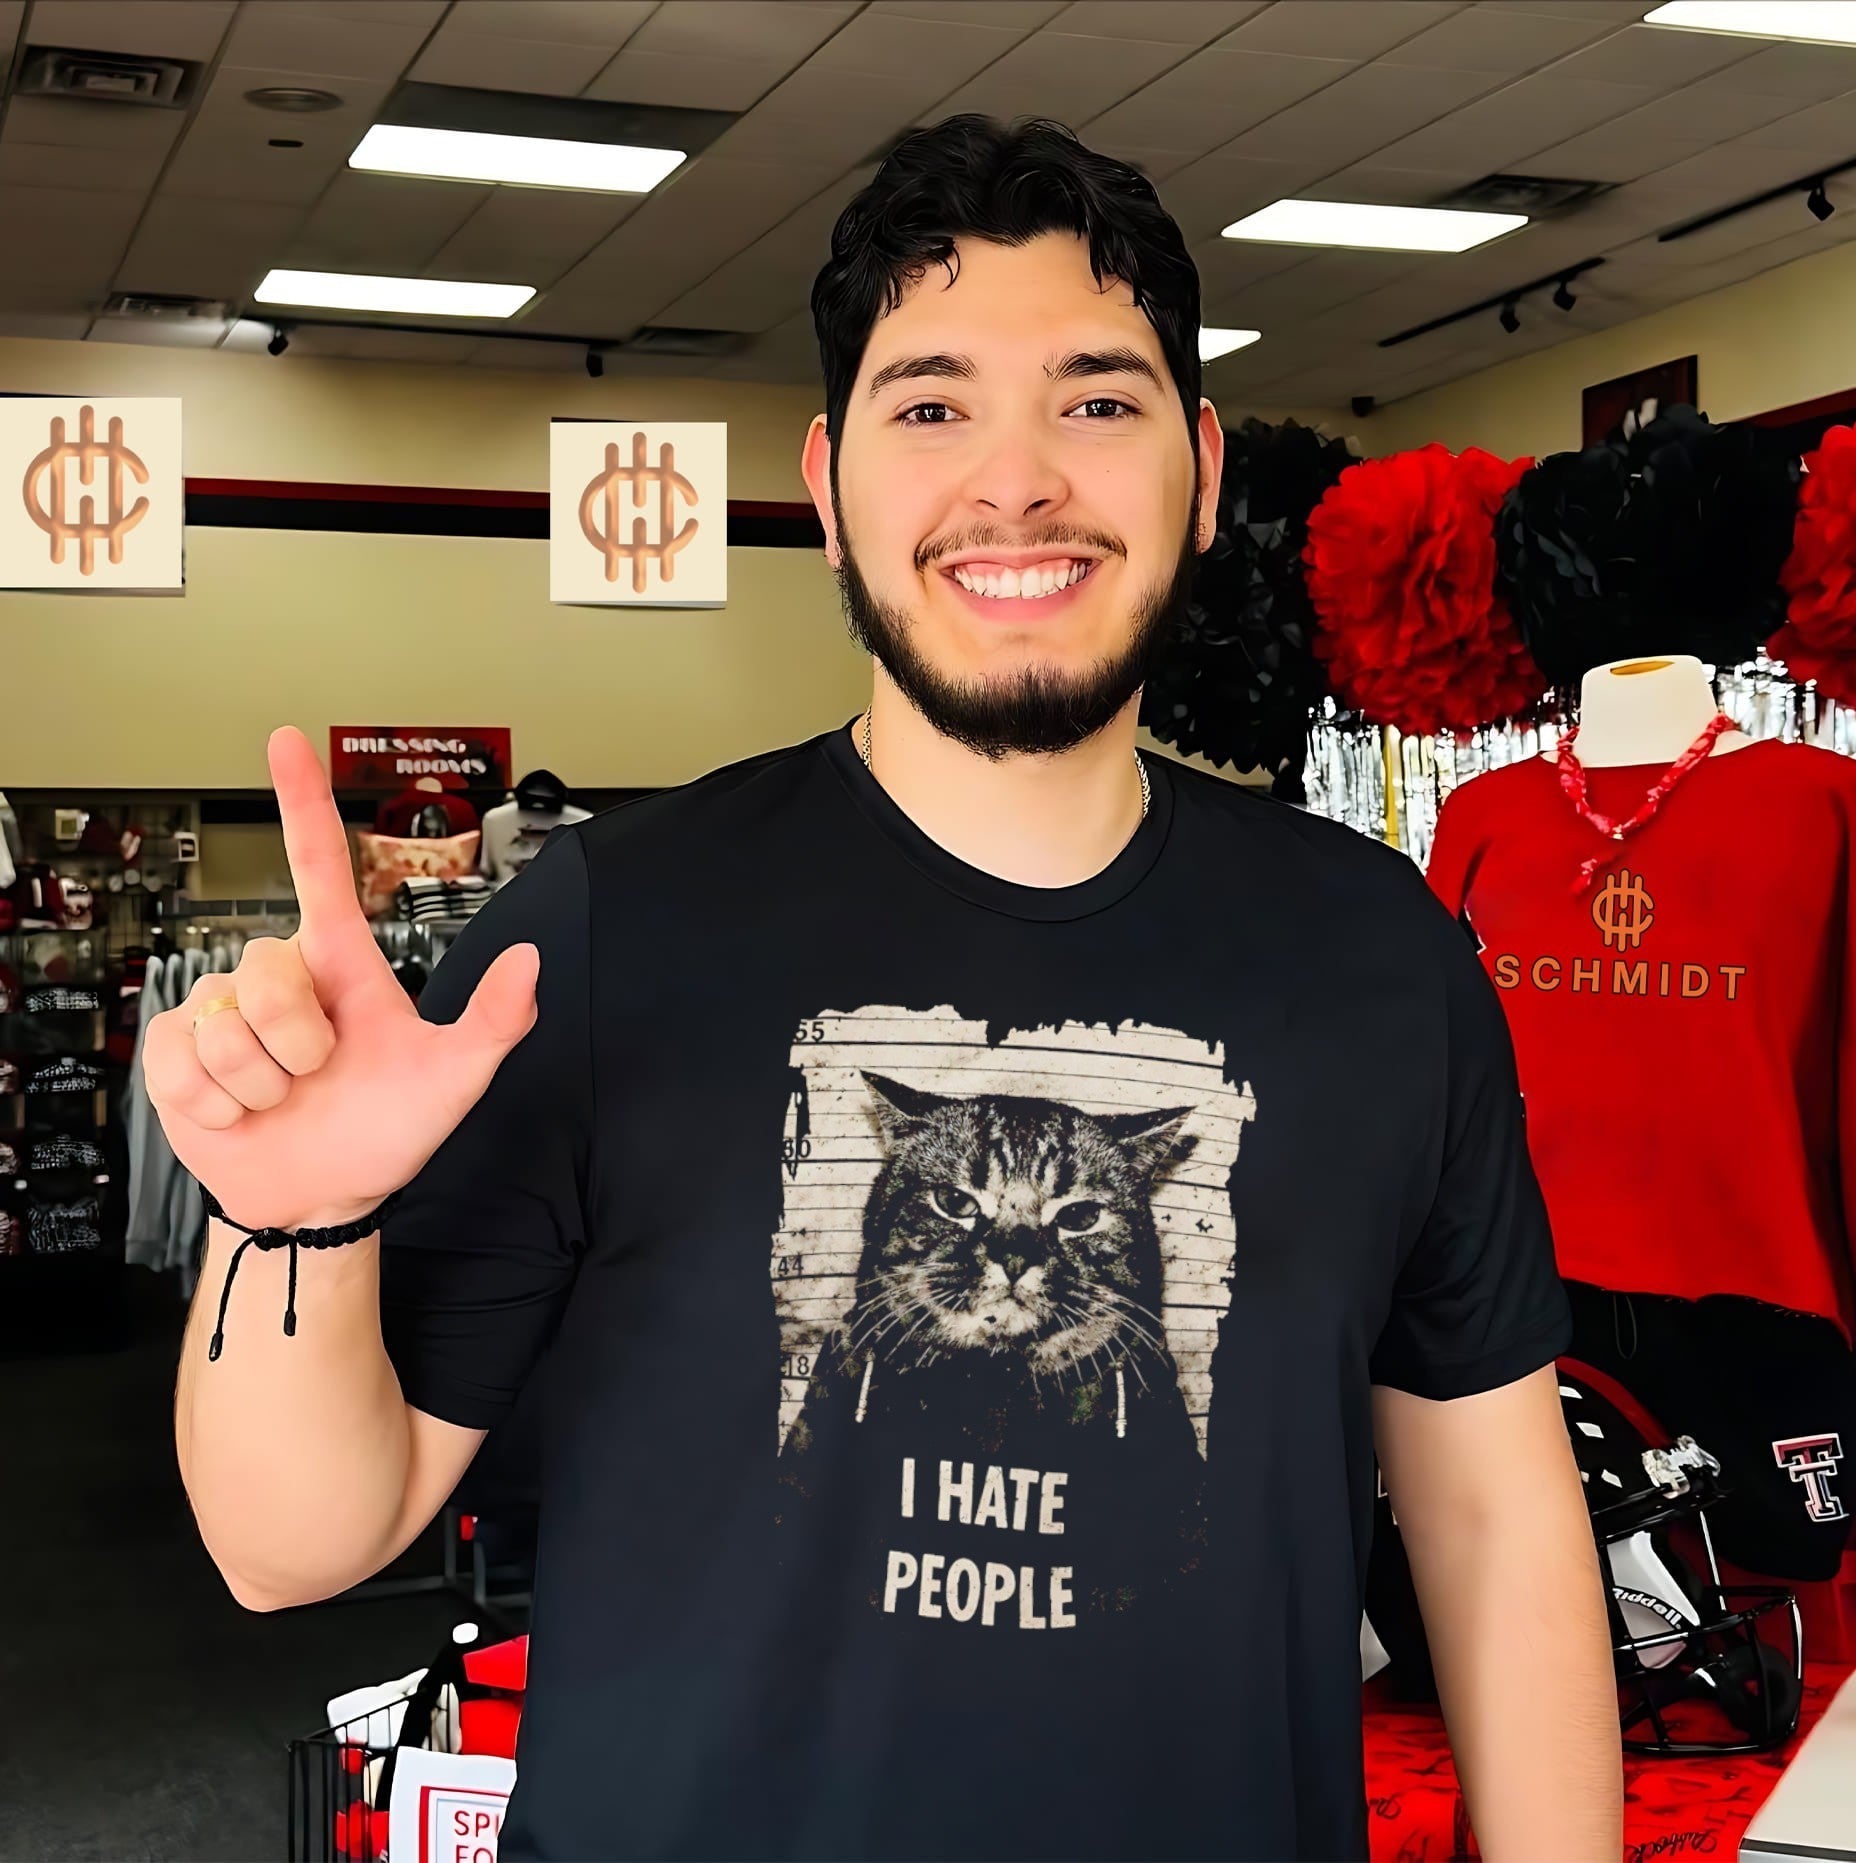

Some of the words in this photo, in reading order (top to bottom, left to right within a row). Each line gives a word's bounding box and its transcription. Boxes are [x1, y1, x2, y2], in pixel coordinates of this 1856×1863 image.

[396, 758, 487, 775] ROOMS
[1494, 954, 1747, 1000] SCHMIDT
[778, 1254, 804, 1276] 44
[901, 1457, 916, 1518] I
[937, 1460, 1068, 1535] HATE
[882, 1550, 1076, 1630] PEOPLE
